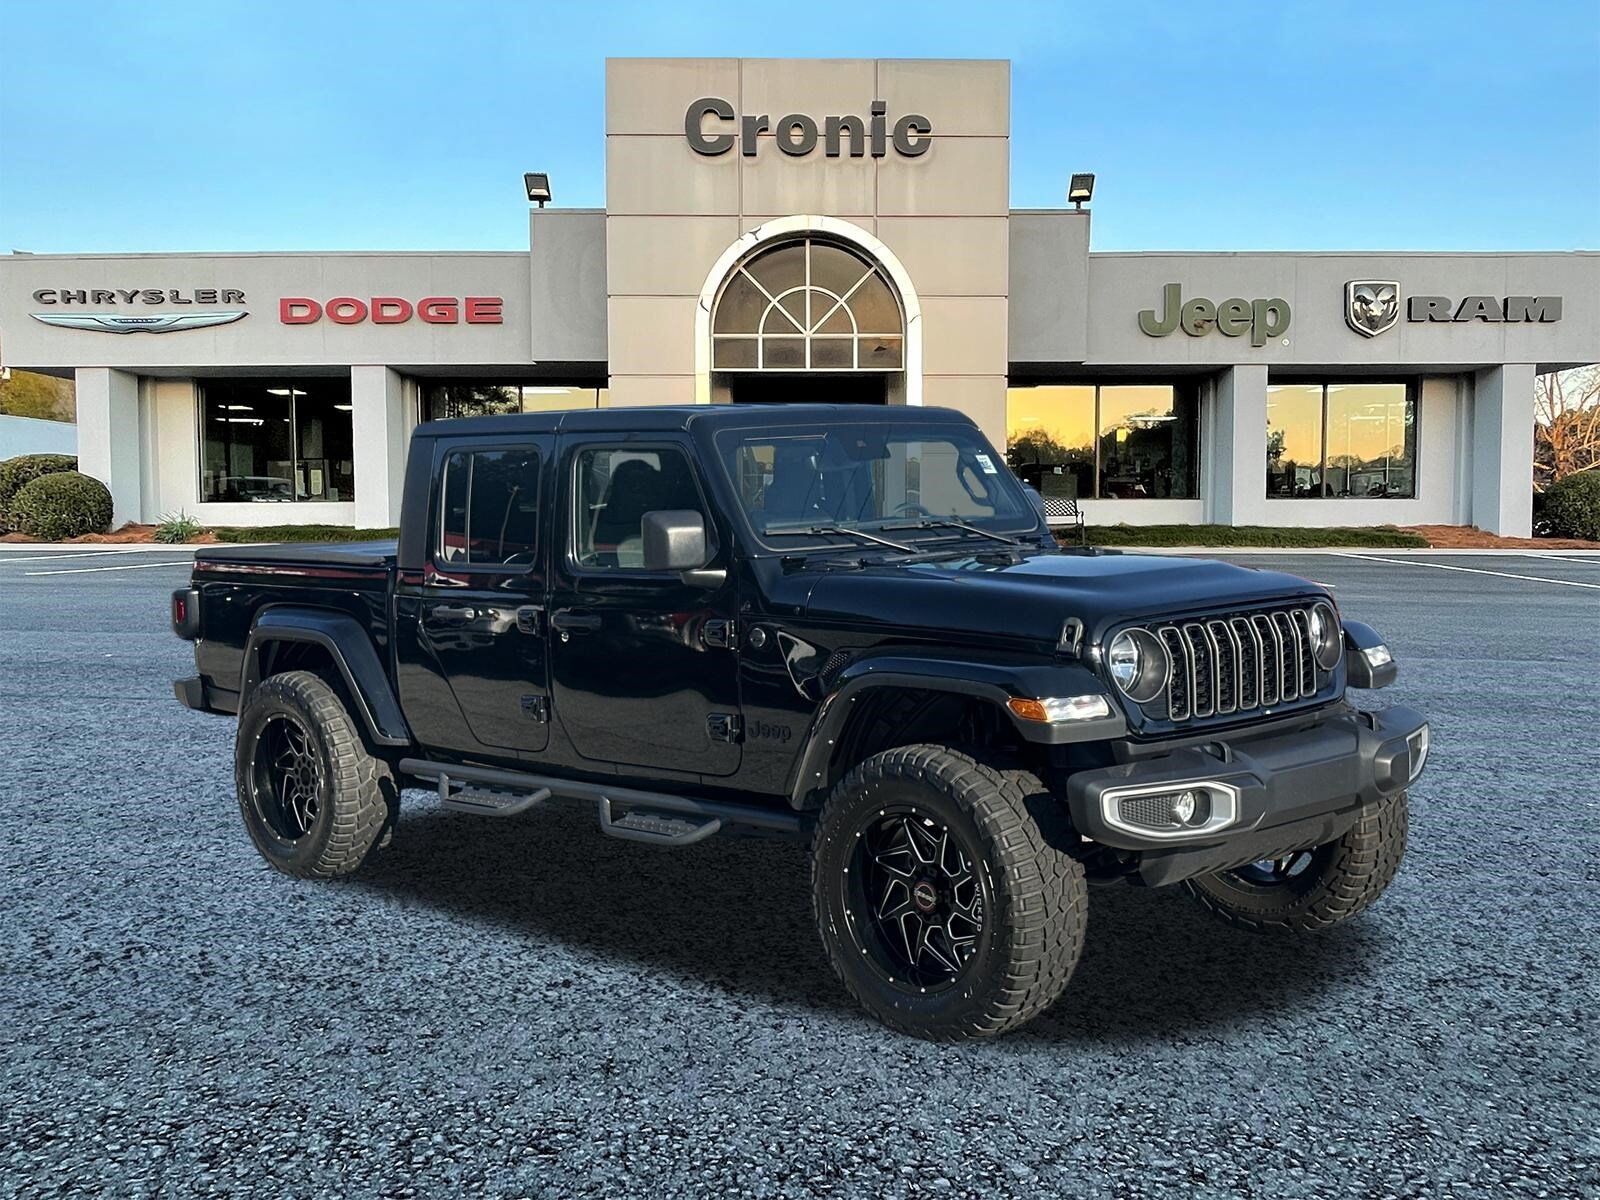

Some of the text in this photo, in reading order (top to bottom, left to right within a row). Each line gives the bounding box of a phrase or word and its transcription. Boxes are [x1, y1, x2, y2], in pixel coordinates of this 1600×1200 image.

[685, 98, 932, 157] Cronic
[32, 288, 247, 305] CHRYSLER
[1407, 296, 1562, 322] RAM
[279, 296, 504, 325] DODGE
[1138, 283, 1292, 347] Jeep
[748, 720, 792, 744] Jeep
